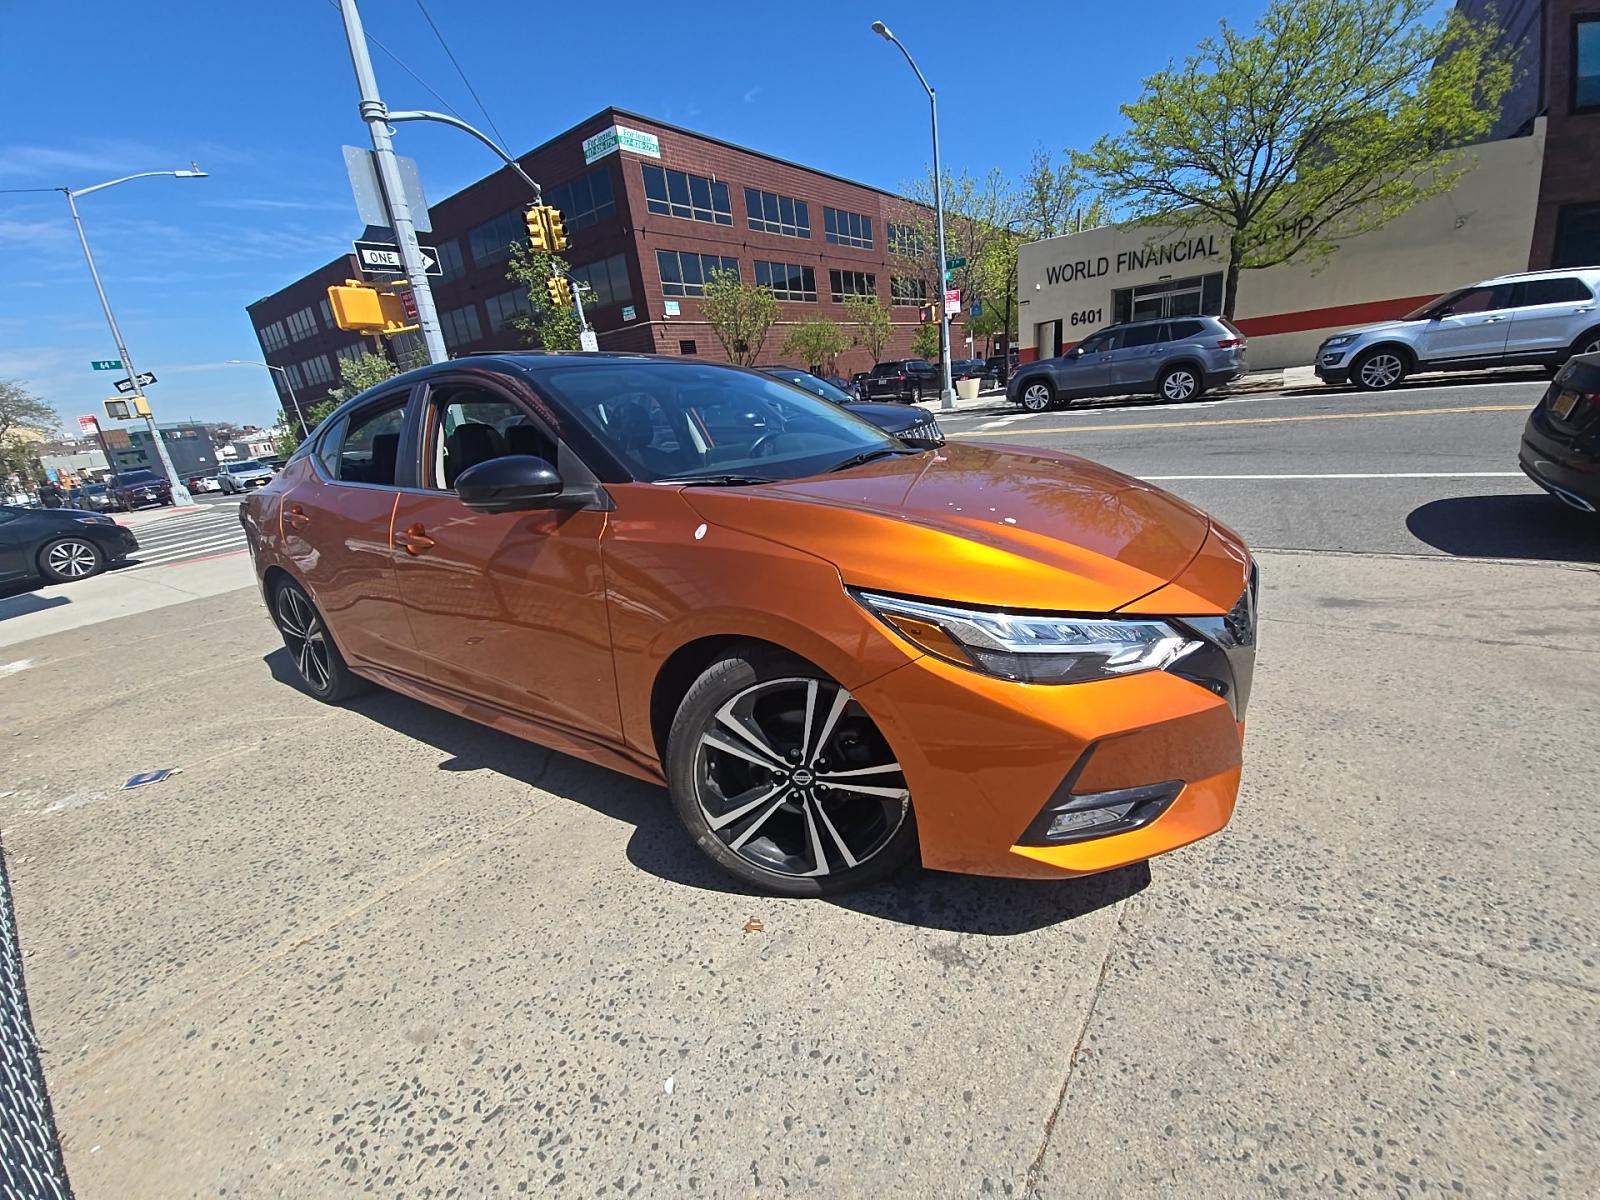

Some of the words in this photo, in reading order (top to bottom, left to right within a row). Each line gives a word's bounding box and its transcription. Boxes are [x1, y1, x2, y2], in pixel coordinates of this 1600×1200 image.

[370, 252, 395, 264] ONE
[1046, 257, 1109, 285] WORLD
[1117, 235, 1219, 273] FINANCIAL
[1071, 308, 1102, 326] 6401
